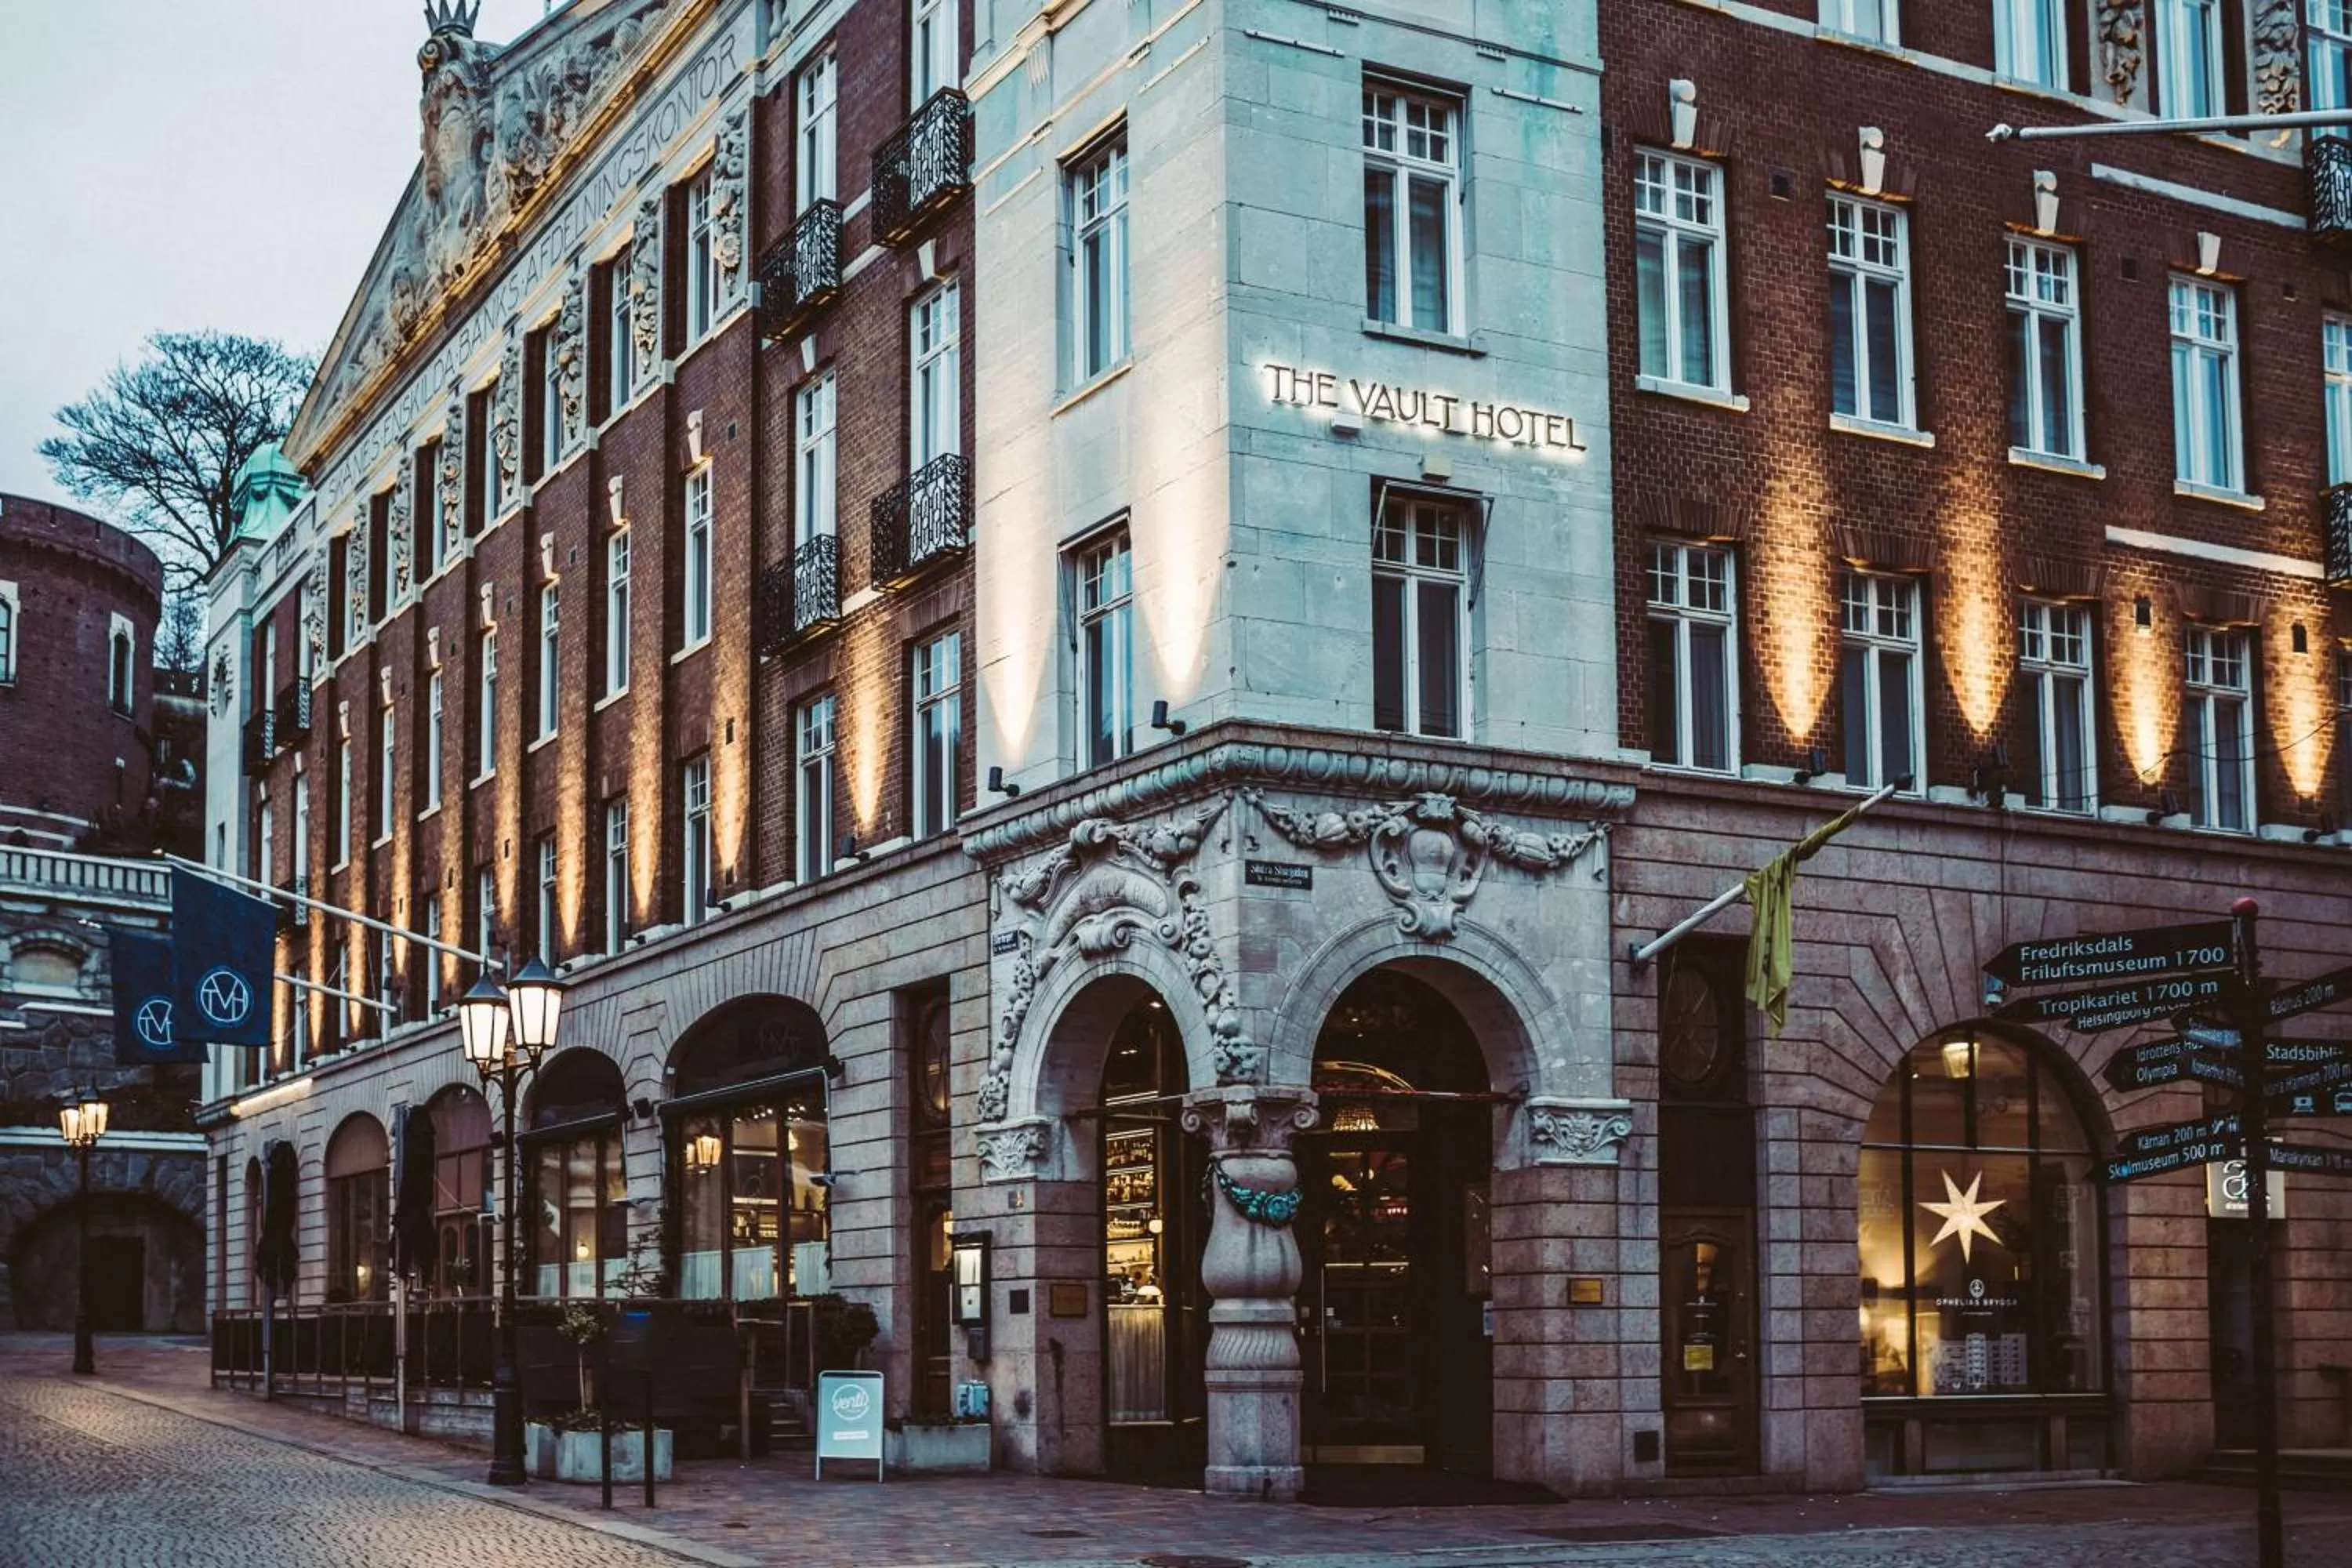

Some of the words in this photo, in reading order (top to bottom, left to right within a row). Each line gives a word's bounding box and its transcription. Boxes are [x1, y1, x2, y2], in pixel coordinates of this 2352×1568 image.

[459, 272, 519, 365] BANKS
[524, 34, 737, 296] AFDELNINGSKONTOR
[1264, 364, 1338, 408] THE
[1348, 378, 1460, 430] VAULT
[1471, 401, 1588, 452] HOTEL
[2020, 935, 2133, 961] Fredriksdals
[2021, 955, 2166, 981] Friluftsmuseum
[2175, 946, 2225, 967] 1700
[2038, 990, 2139, 1014] Tropikariet
[2147, 981, 2194, 1002] 1700
[2200, 980, 2218, 995] m
[2325, 983, 2334, 998] m
[2136, 1062, 2178, 1083] Olympia
[2174, 1126, 2194, 1144] 200
[2196, 1126, 2207, 1138] m
[2107, 1152, 2180, 1180] Sklmuseum
[2182, 1144, 2206, 1163] 500
[2210, 1143, 2226, 1156] m
